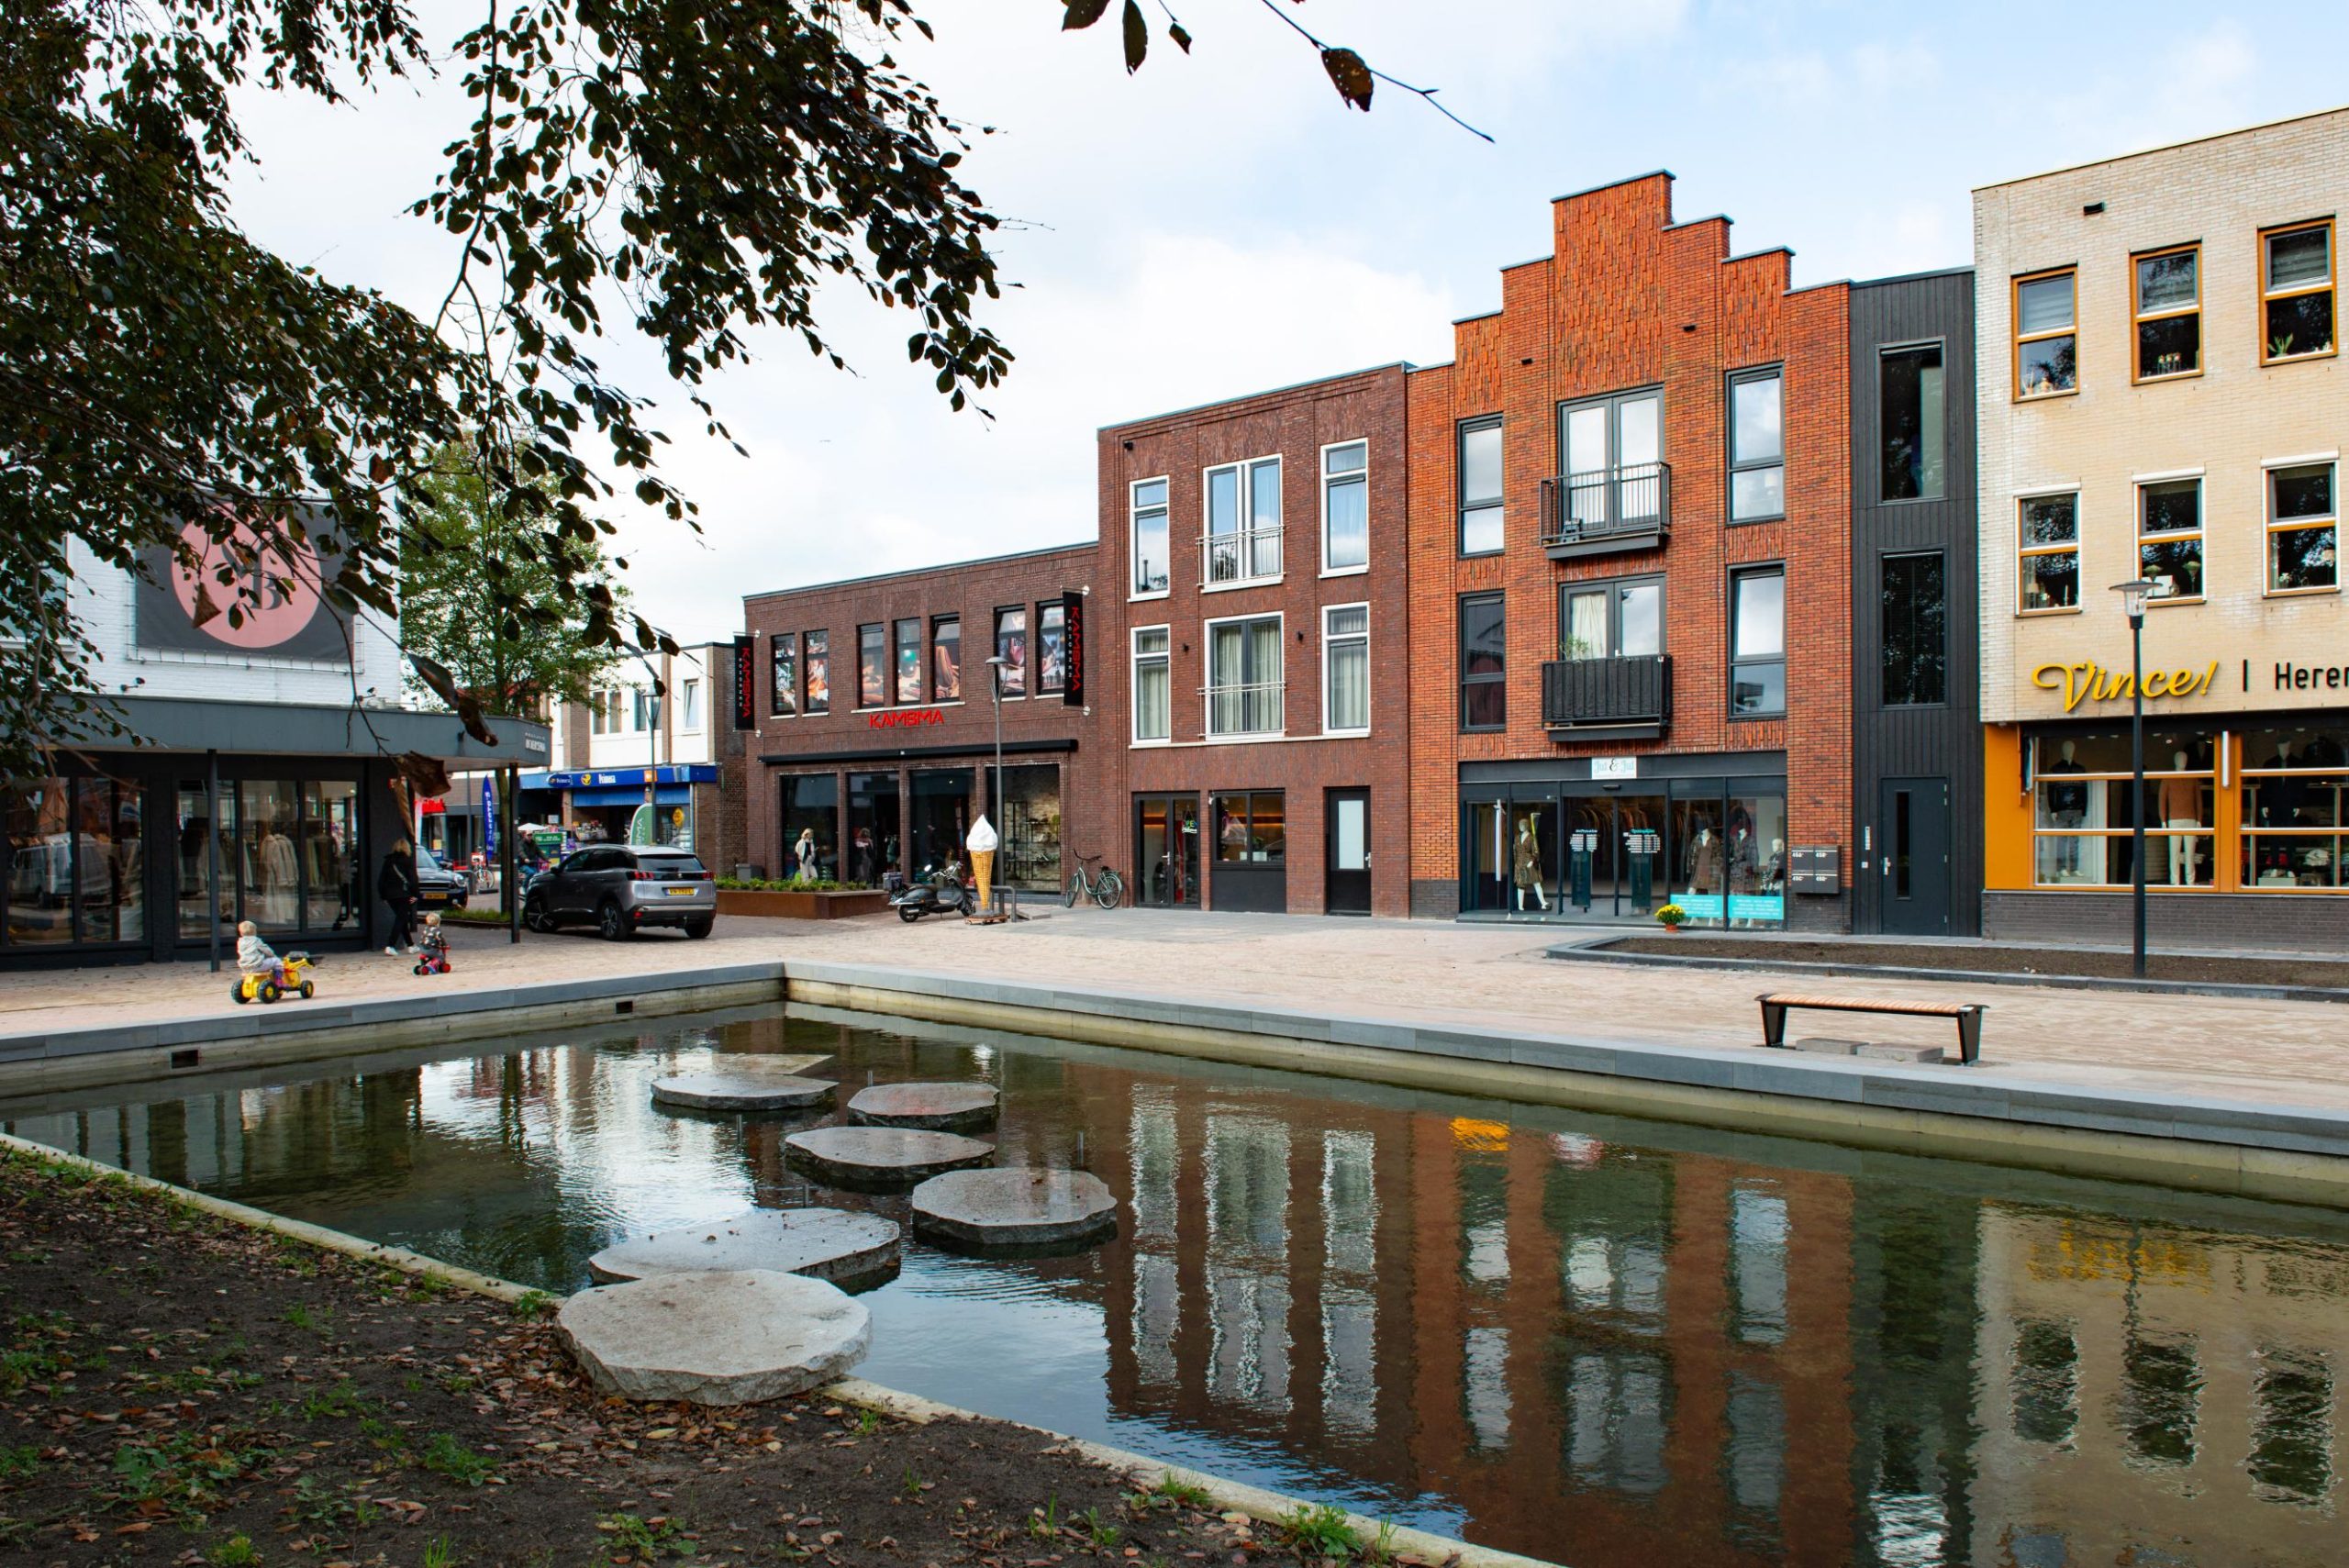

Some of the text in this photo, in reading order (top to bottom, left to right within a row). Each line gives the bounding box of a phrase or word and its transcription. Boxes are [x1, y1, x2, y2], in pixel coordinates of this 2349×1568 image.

[1072, 606, 1081, 691] KAMSMA
[741, 647, 751, 717] KAMSMA
[2032, 659, 2219, 713] Vince!
[869, 708, 944, 728] KAMSMA
